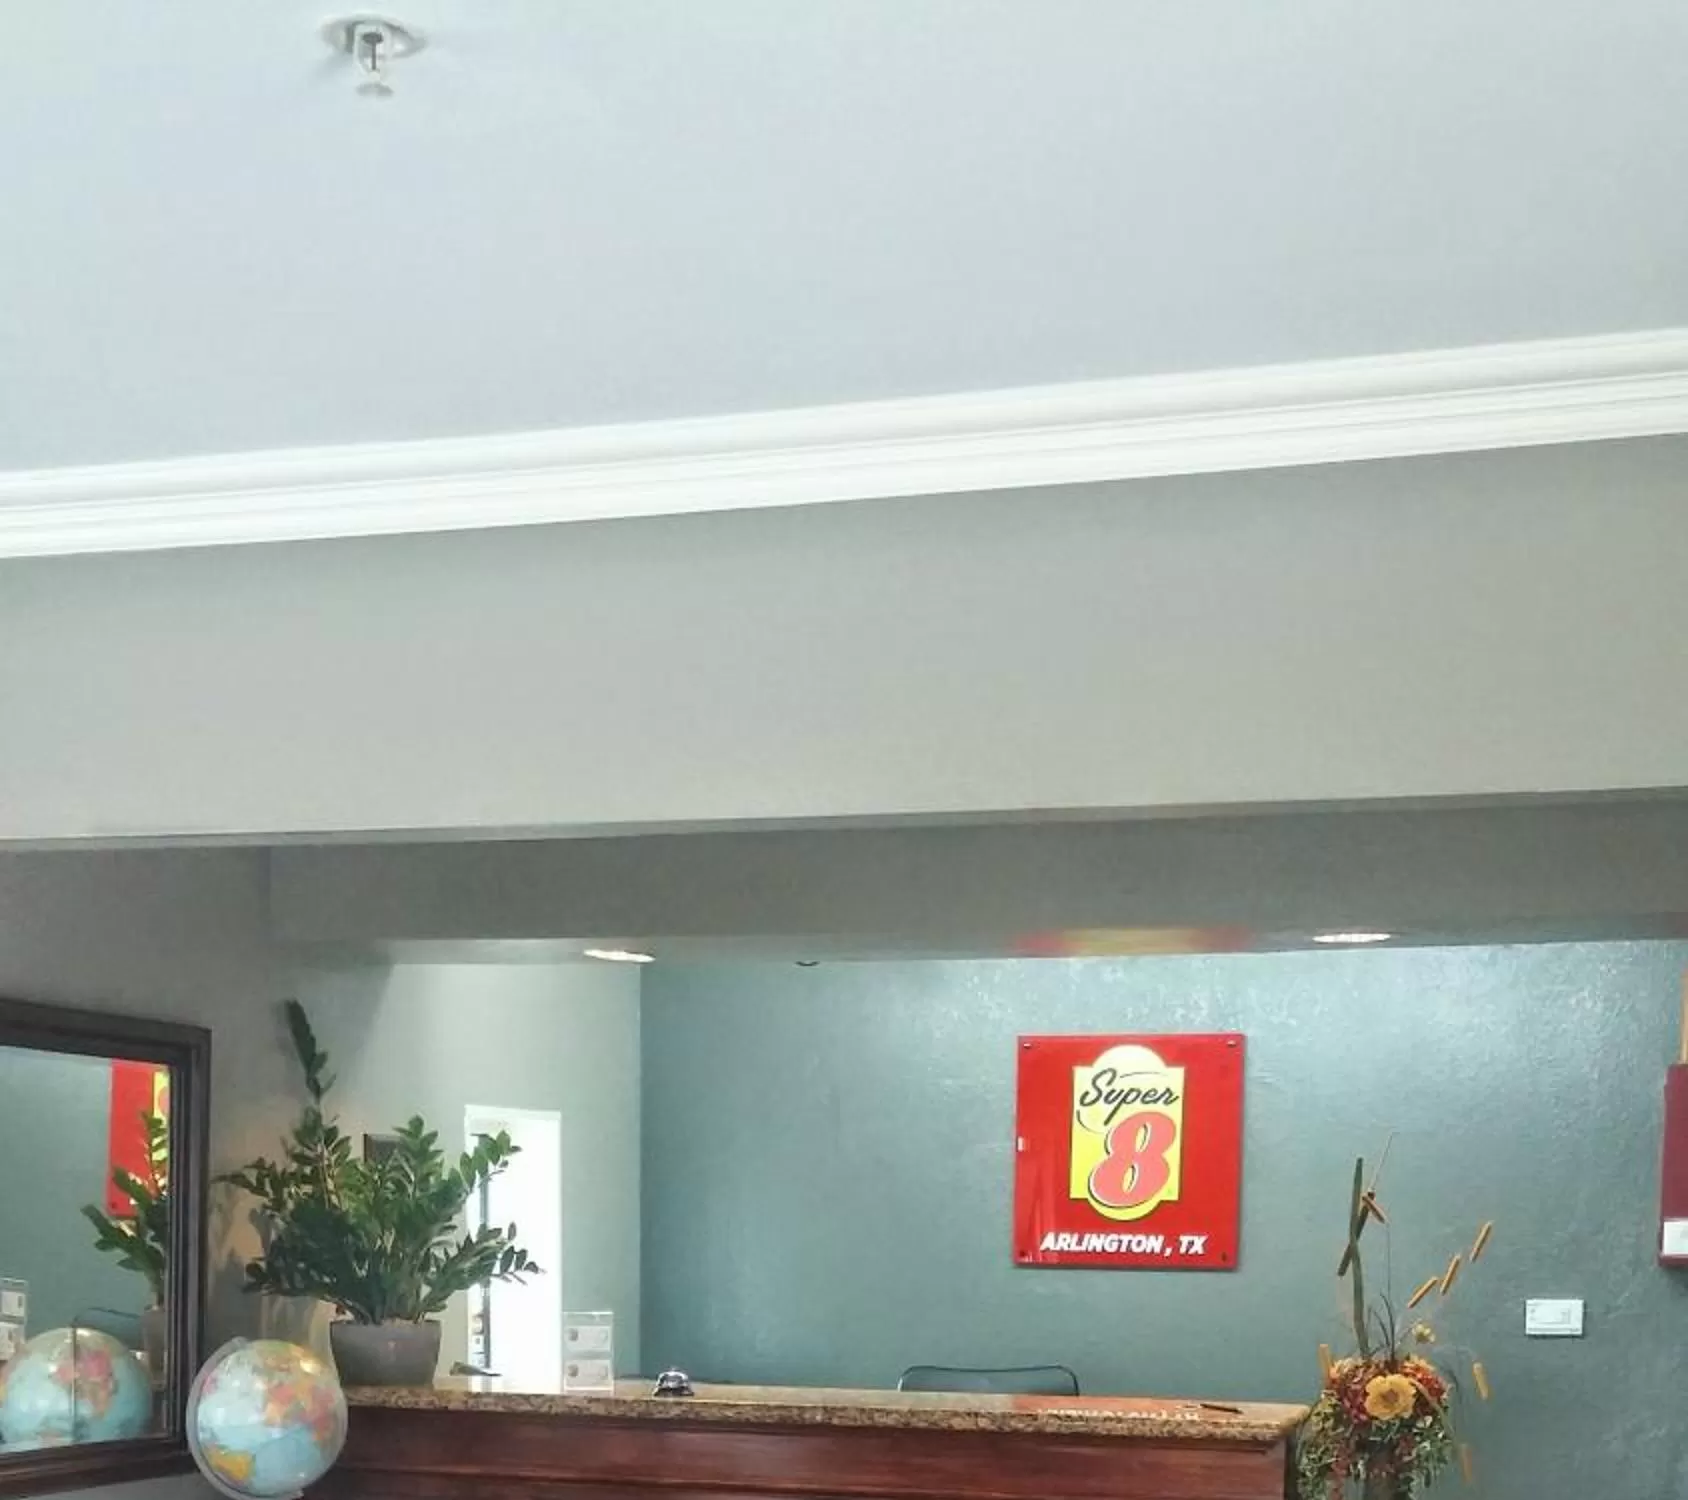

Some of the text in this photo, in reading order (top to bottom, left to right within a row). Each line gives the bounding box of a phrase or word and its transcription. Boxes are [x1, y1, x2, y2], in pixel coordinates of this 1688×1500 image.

[1079, 1069, 1179, 1126] Super
[1089, 1111, 1176, 1208] 8
[1041, 1233, 1207, 1256] ARLINGTON, TX
